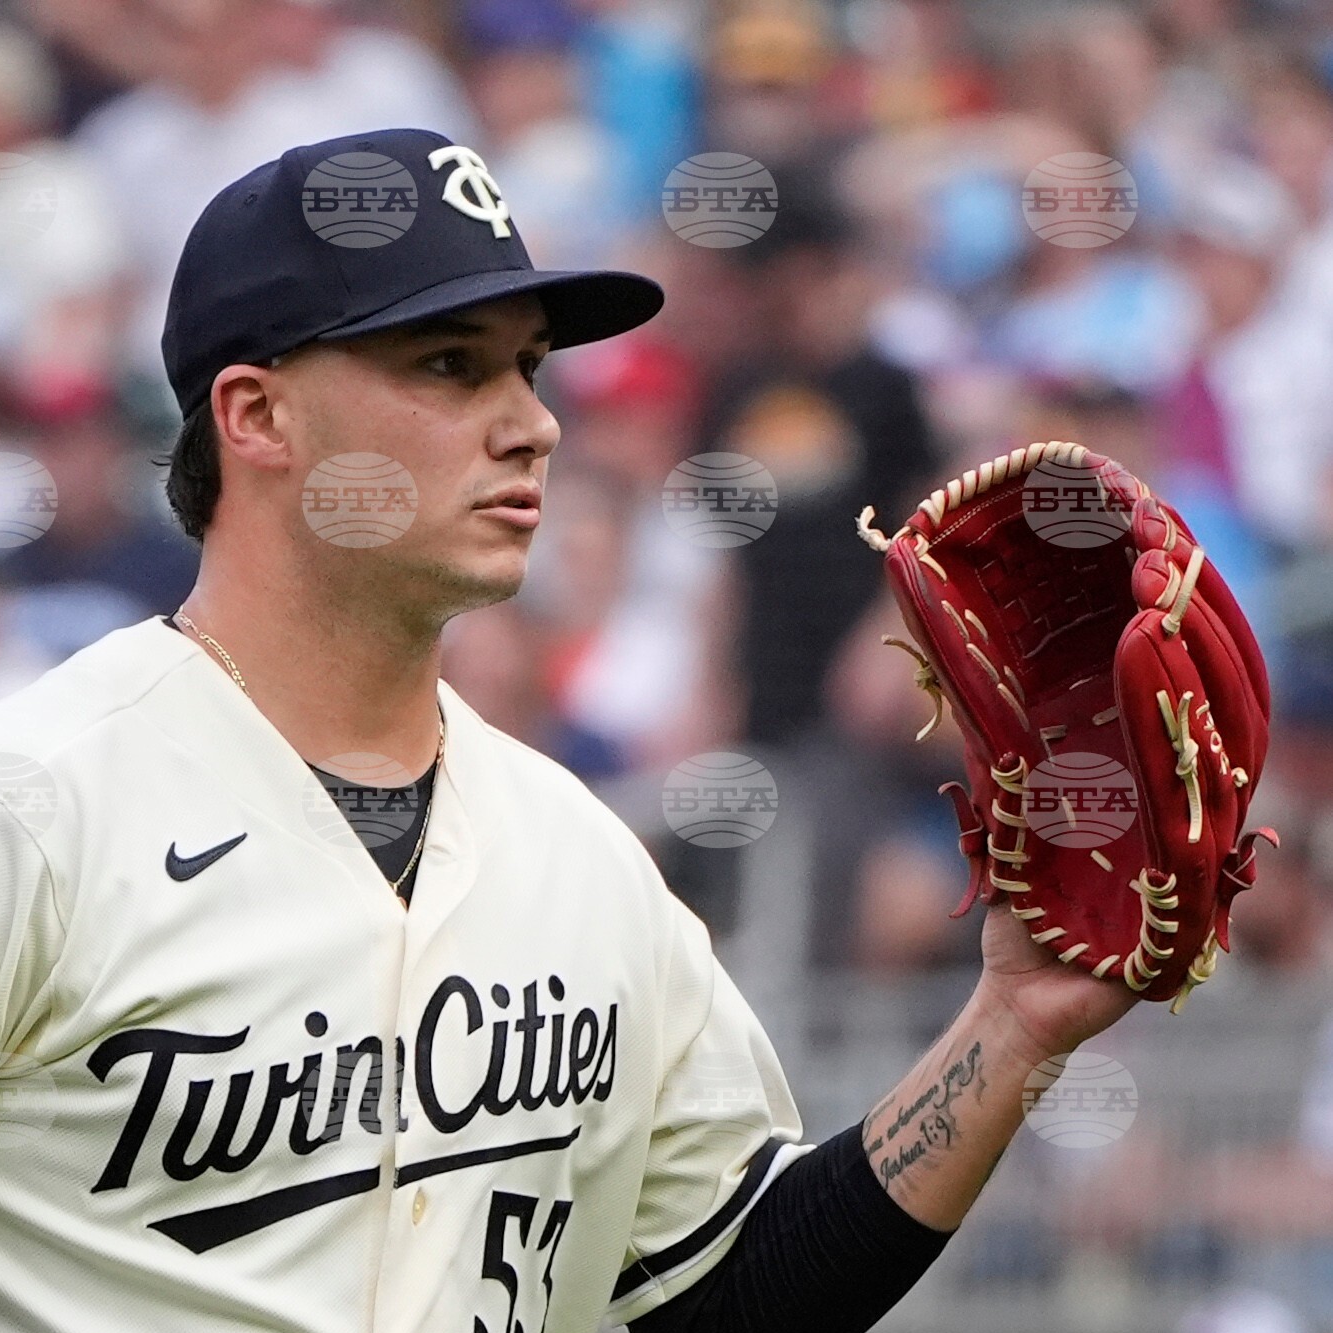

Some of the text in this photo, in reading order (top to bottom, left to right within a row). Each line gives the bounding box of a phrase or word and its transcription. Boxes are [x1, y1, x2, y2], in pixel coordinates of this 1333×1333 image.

[86, 974, 618, 1194] Twin Cities
[919, 1114, 951, 1147] 1:9
